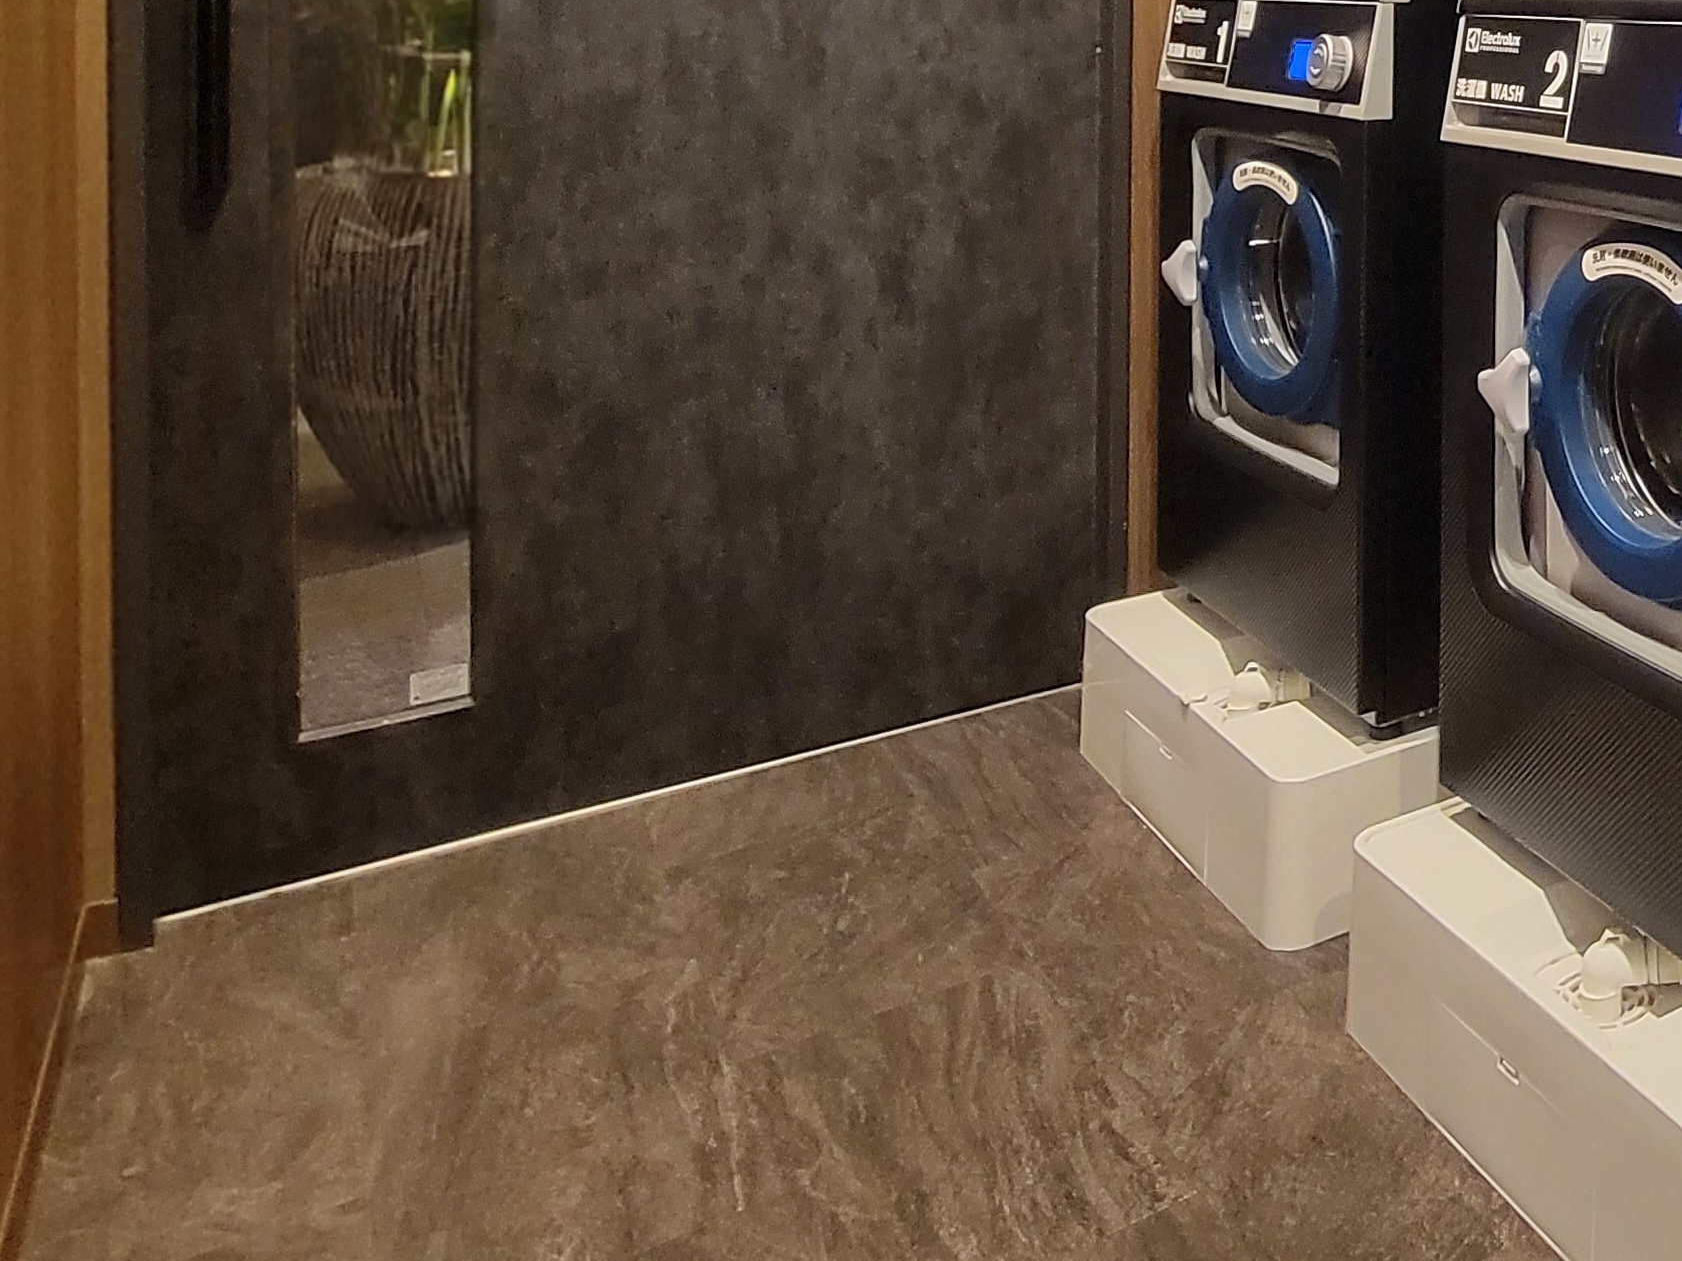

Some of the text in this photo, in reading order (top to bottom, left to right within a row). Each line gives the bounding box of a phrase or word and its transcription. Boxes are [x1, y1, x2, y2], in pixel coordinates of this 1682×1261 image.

[1216, 20, 1229, 64] 1
[1480, 30, 1522, 47] Electrolux
[1490, 82, 1526, 103] WASH
[1539, 49, 1569, 109] 2
